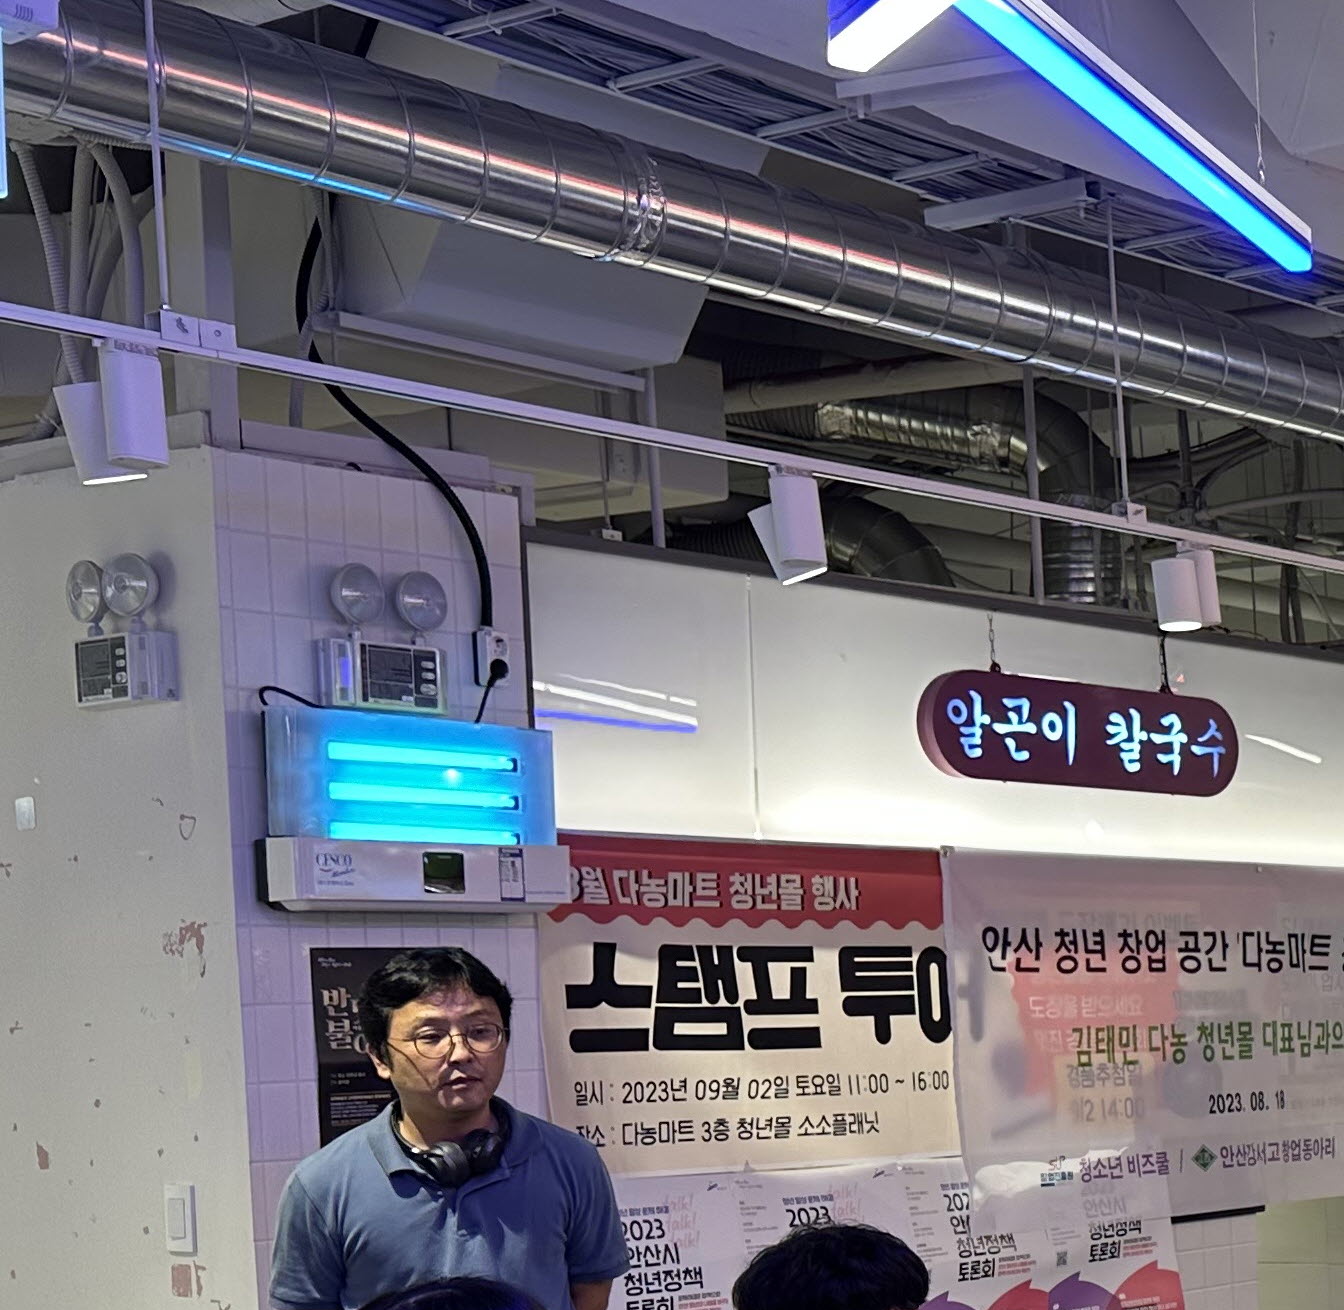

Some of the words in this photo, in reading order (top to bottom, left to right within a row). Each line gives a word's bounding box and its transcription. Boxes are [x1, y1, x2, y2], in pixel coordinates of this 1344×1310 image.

[947, 690, 1077, 766] 알곤이
[1104, 708, 1226, 778] 칼국수
[316, 853, 352, 866] CESCO
[613, 868, 720, 908] 다농마트
[729, 873, 804, 911] 청년몰
[812, 873, 861, 912] 행사
[981, 924, 1043, 974] 안산
[1054, 927, 1107, 975] 청년
[1117, 928, 1167, 975] 창업
[1177, 929, 1230, 975] 공간
[565, 942, 822, 1054] 스탬프
[1071, 1025, 1140, 1067] 김태민
[1148, 1023, 1188, 1065] 다농
[1196, 1021, 1255, 1063] 청년몰
[574, 1081, 604, 1107] 일시
[622, 1077, 688, 1104] 2023년
[695, 1076, 741, 1102] 09월
[748, 1075, 790, 1101] 02일
[796, 1073, 842, 1098] 토요일
[847, 1073, 890, 1096] 11:00
[912, 1070, 950, 1092] 16:00
[1208, 1093, 1247, 1116] 2023.
[1250, 1092, 1271, 1114] 08.
[622, 1120, 695, 1147] 다농마트
[701, 1118, 731, 1143] 3층
[736, 1115, 792, 1141] 청년몰
[797, 1110, 880, 1138] 소소플래닛
[1079, 1152, 1124, 1186] 청소년
[1127, 1149, 1171, 1181] 비즈쿨
[785, 1206, 831, 1228] 2023
[956, 1232, 1018, 1258] 청년정책
[1089, 1239, 1121, 1263] 토론회
[624, 1266, 704, 1297] 청년정책
[958, 1257, 996, 1282] 토론회
